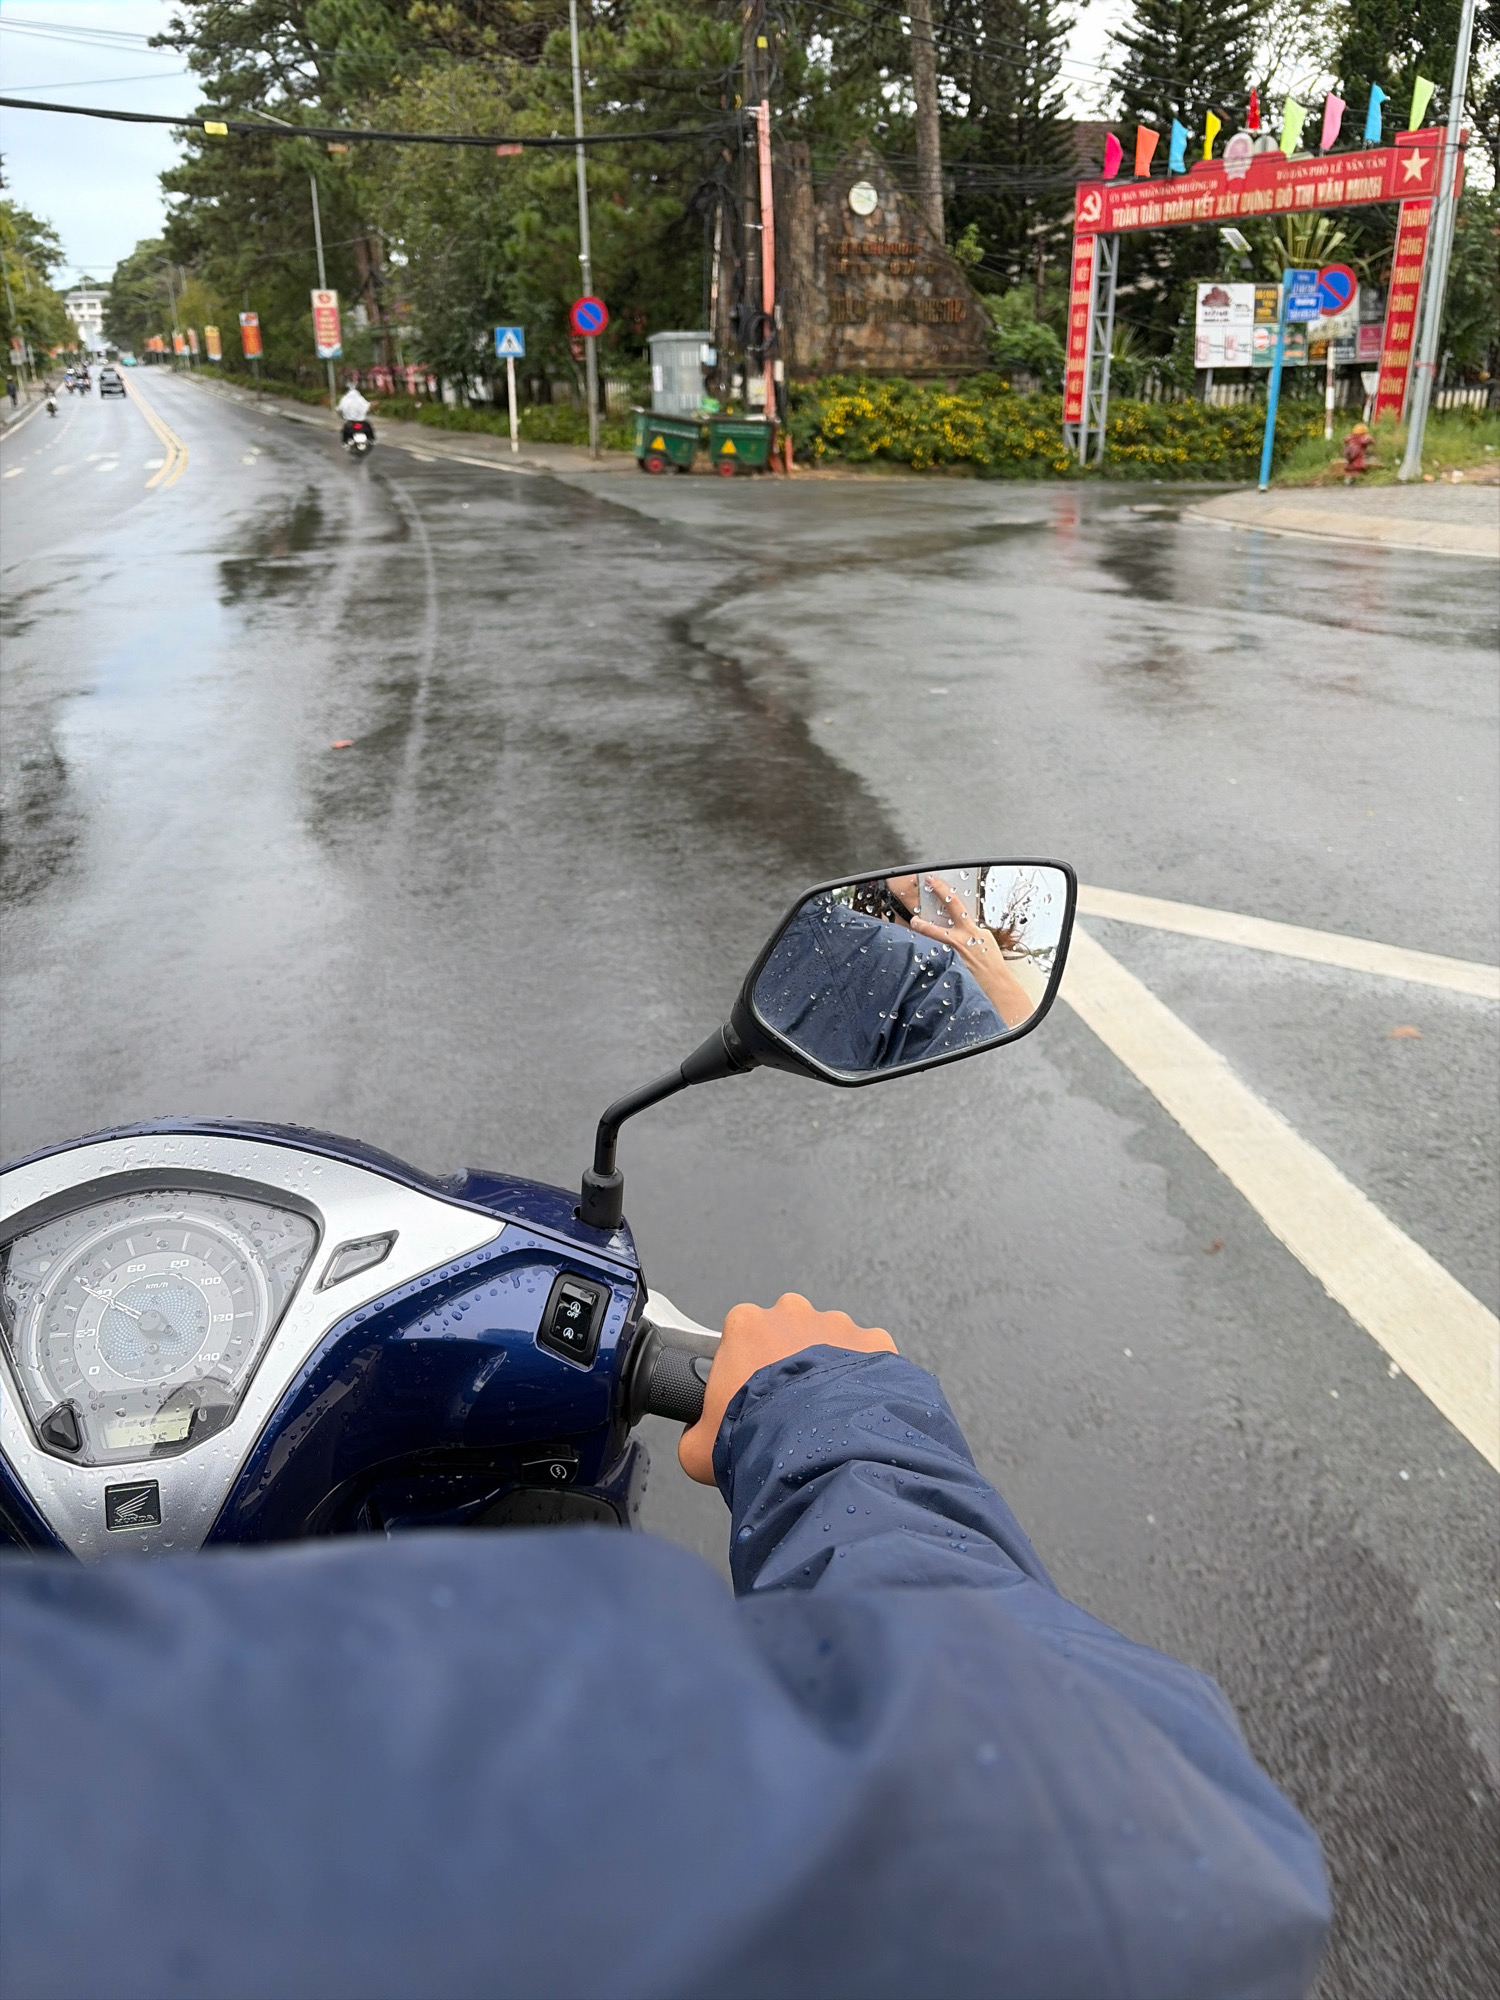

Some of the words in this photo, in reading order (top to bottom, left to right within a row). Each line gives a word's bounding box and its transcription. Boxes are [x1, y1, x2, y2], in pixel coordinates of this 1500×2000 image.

[127, 1264, 146, 1273] 60
[200, 1276, 222, 1285] 100
[145, 1282, 168, 1290] km/h
[212, 1313, 234, 1322] 120
[567, 1310, 580, 1319] OFF
[75, 1329, 96, 1338] 20
[198, 1352, 220, 1362] 140
[88, 1366, 100, 1375] 0
[114, 1515, 155, 1525] HONDA
